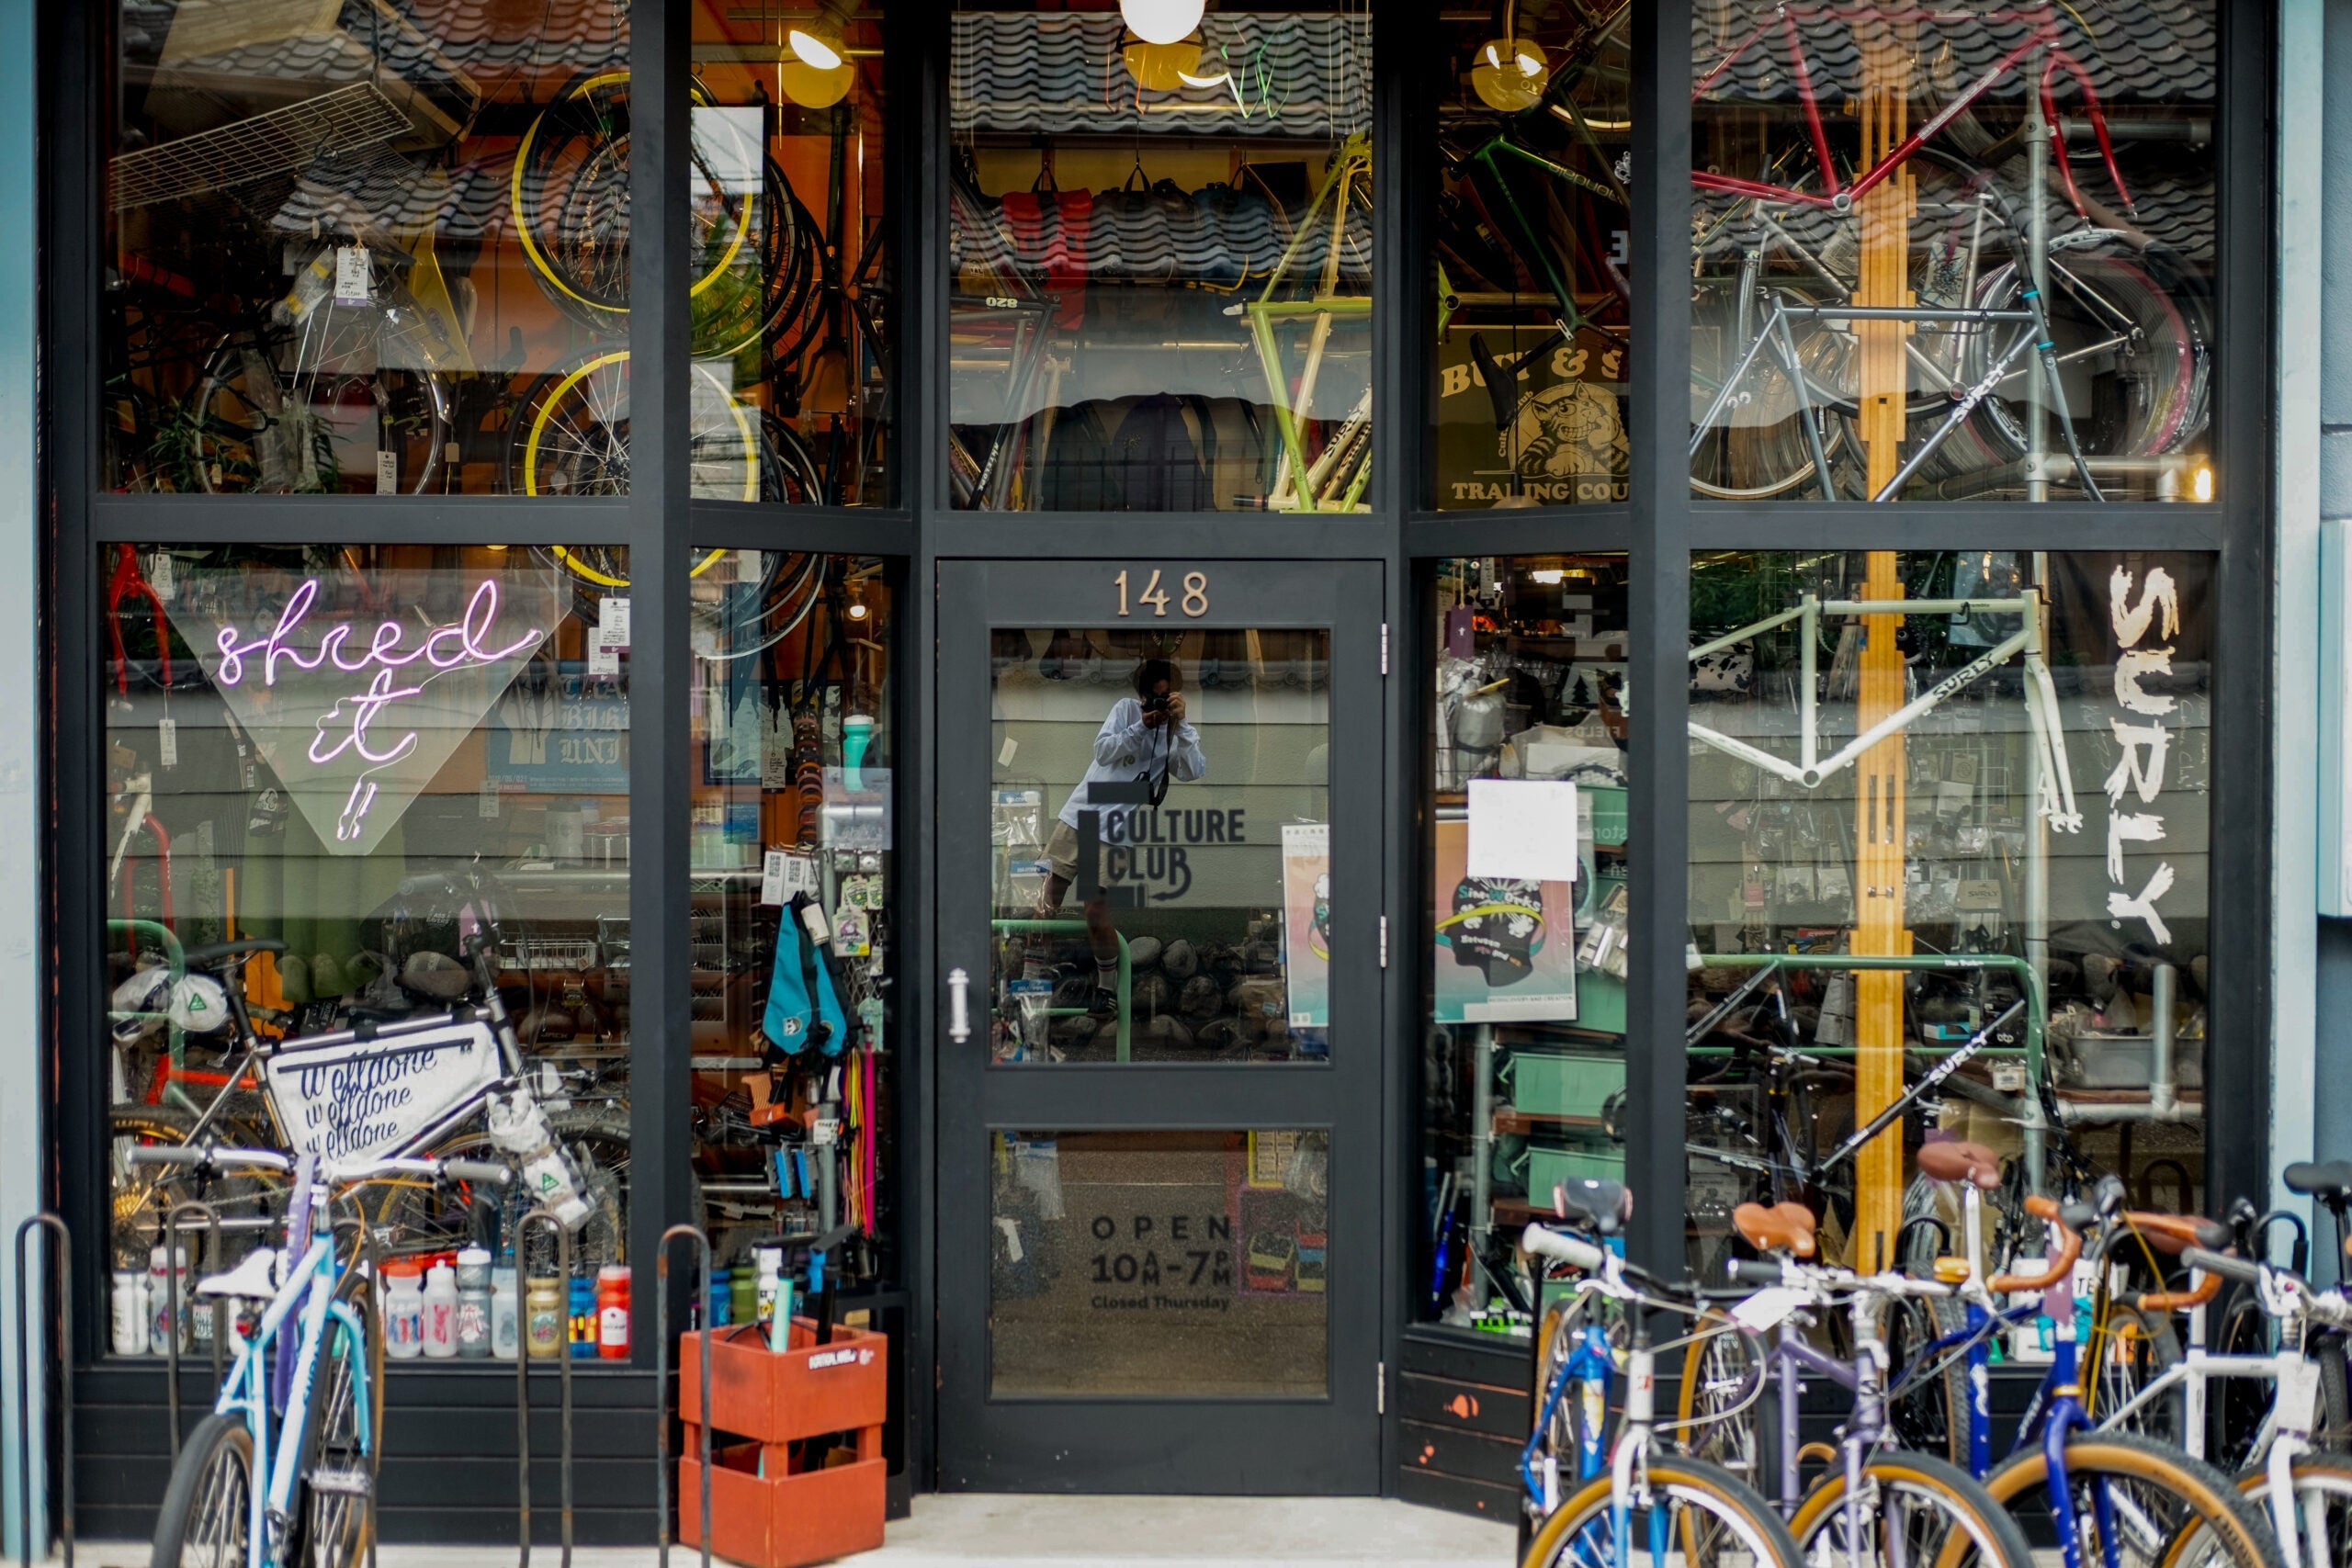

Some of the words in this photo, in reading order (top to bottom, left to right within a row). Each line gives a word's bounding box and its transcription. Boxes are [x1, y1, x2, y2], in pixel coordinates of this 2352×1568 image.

[986, 297, 1018, 309] 820
[1551, 347, 1589, 378] &
[1577, 482, 1629, 500] COU
[1114, 569, 1209, 617] 148
[217, 579, 540, 686] shred
[1933, 653, 1993, 701] SURLY
[308, 668, 421, 763] it
[559, 737, 620, 765] UNI
[2104, 565, 2179, 945] SURLY
[1106, 809, 1246, 844] CULTURE
[1107, 846, 1193, 897] CLUB
[1929, 1030, 1987, 1085] SURLY
[1091, 1215, 1230, 1240] OPEN
[1091, 1296, 1148, 1309] Closed
[1155, 1296, 1229, 1313] Thursday
